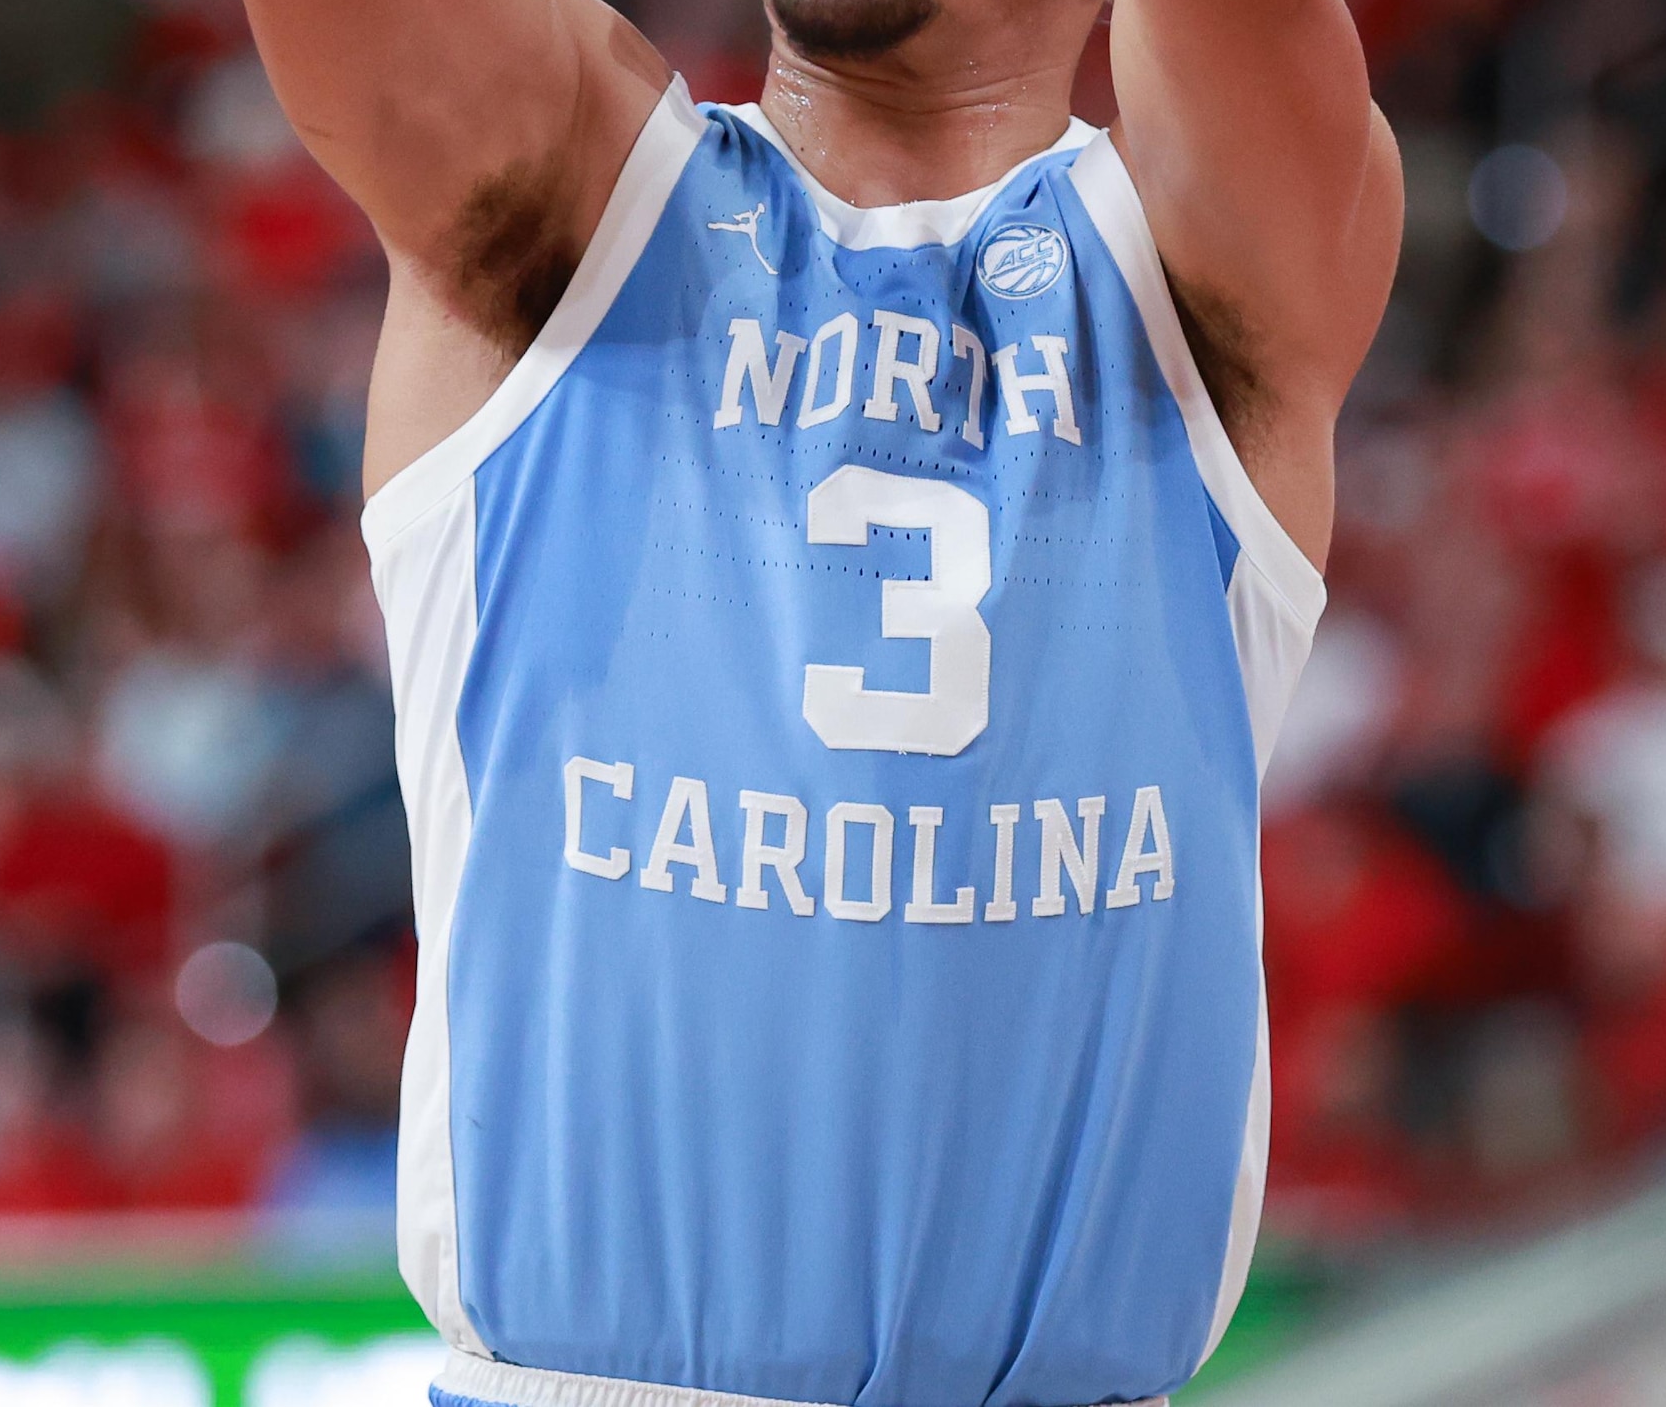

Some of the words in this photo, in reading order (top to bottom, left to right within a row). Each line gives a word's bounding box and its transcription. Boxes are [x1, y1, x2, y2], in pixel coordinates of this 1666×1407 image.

[993, 235, 1056, 271] ACC
[713, 309, 1082, 451] NORTH
[803, 465, 991, 756] 3
[564, 756, 1175, 923] CAROLINA
